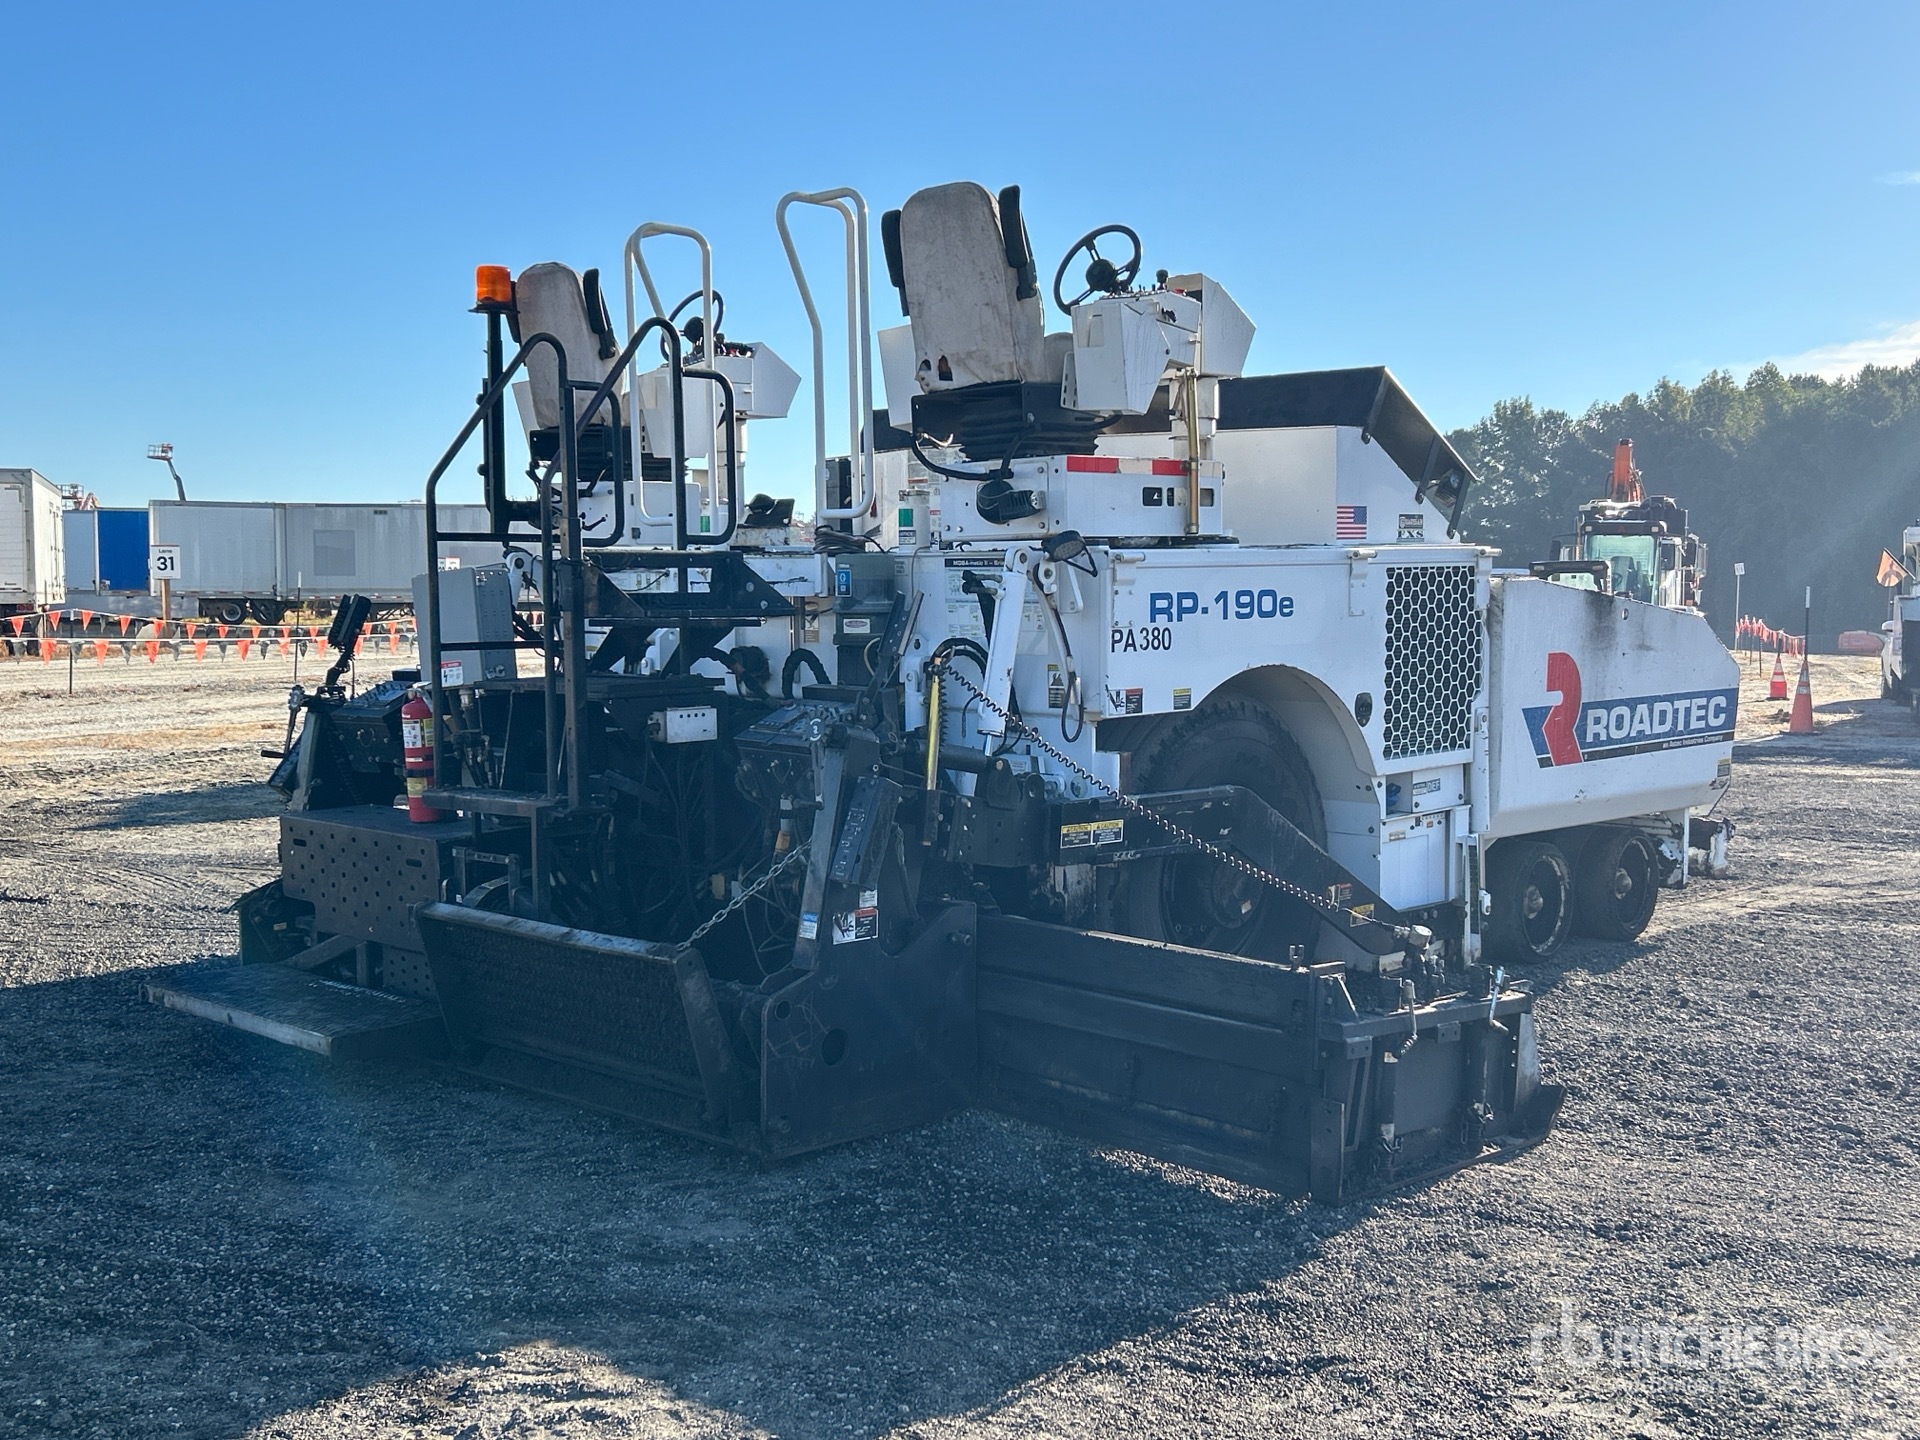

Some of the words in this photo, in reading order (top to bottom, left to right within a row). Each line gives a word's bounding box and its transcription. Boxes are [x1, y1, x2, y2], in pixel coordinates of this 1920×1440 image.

[156, 556, 174, 571] 31
[1149, 588, 1294, 623] RP-190e
[1111, 627, 1172, 652] PA380
[1585, 695, 1727, 743] ROADTEC
[1682, 737, 1704, 746] Industries
[1704, 734, 1724, 743] Company
